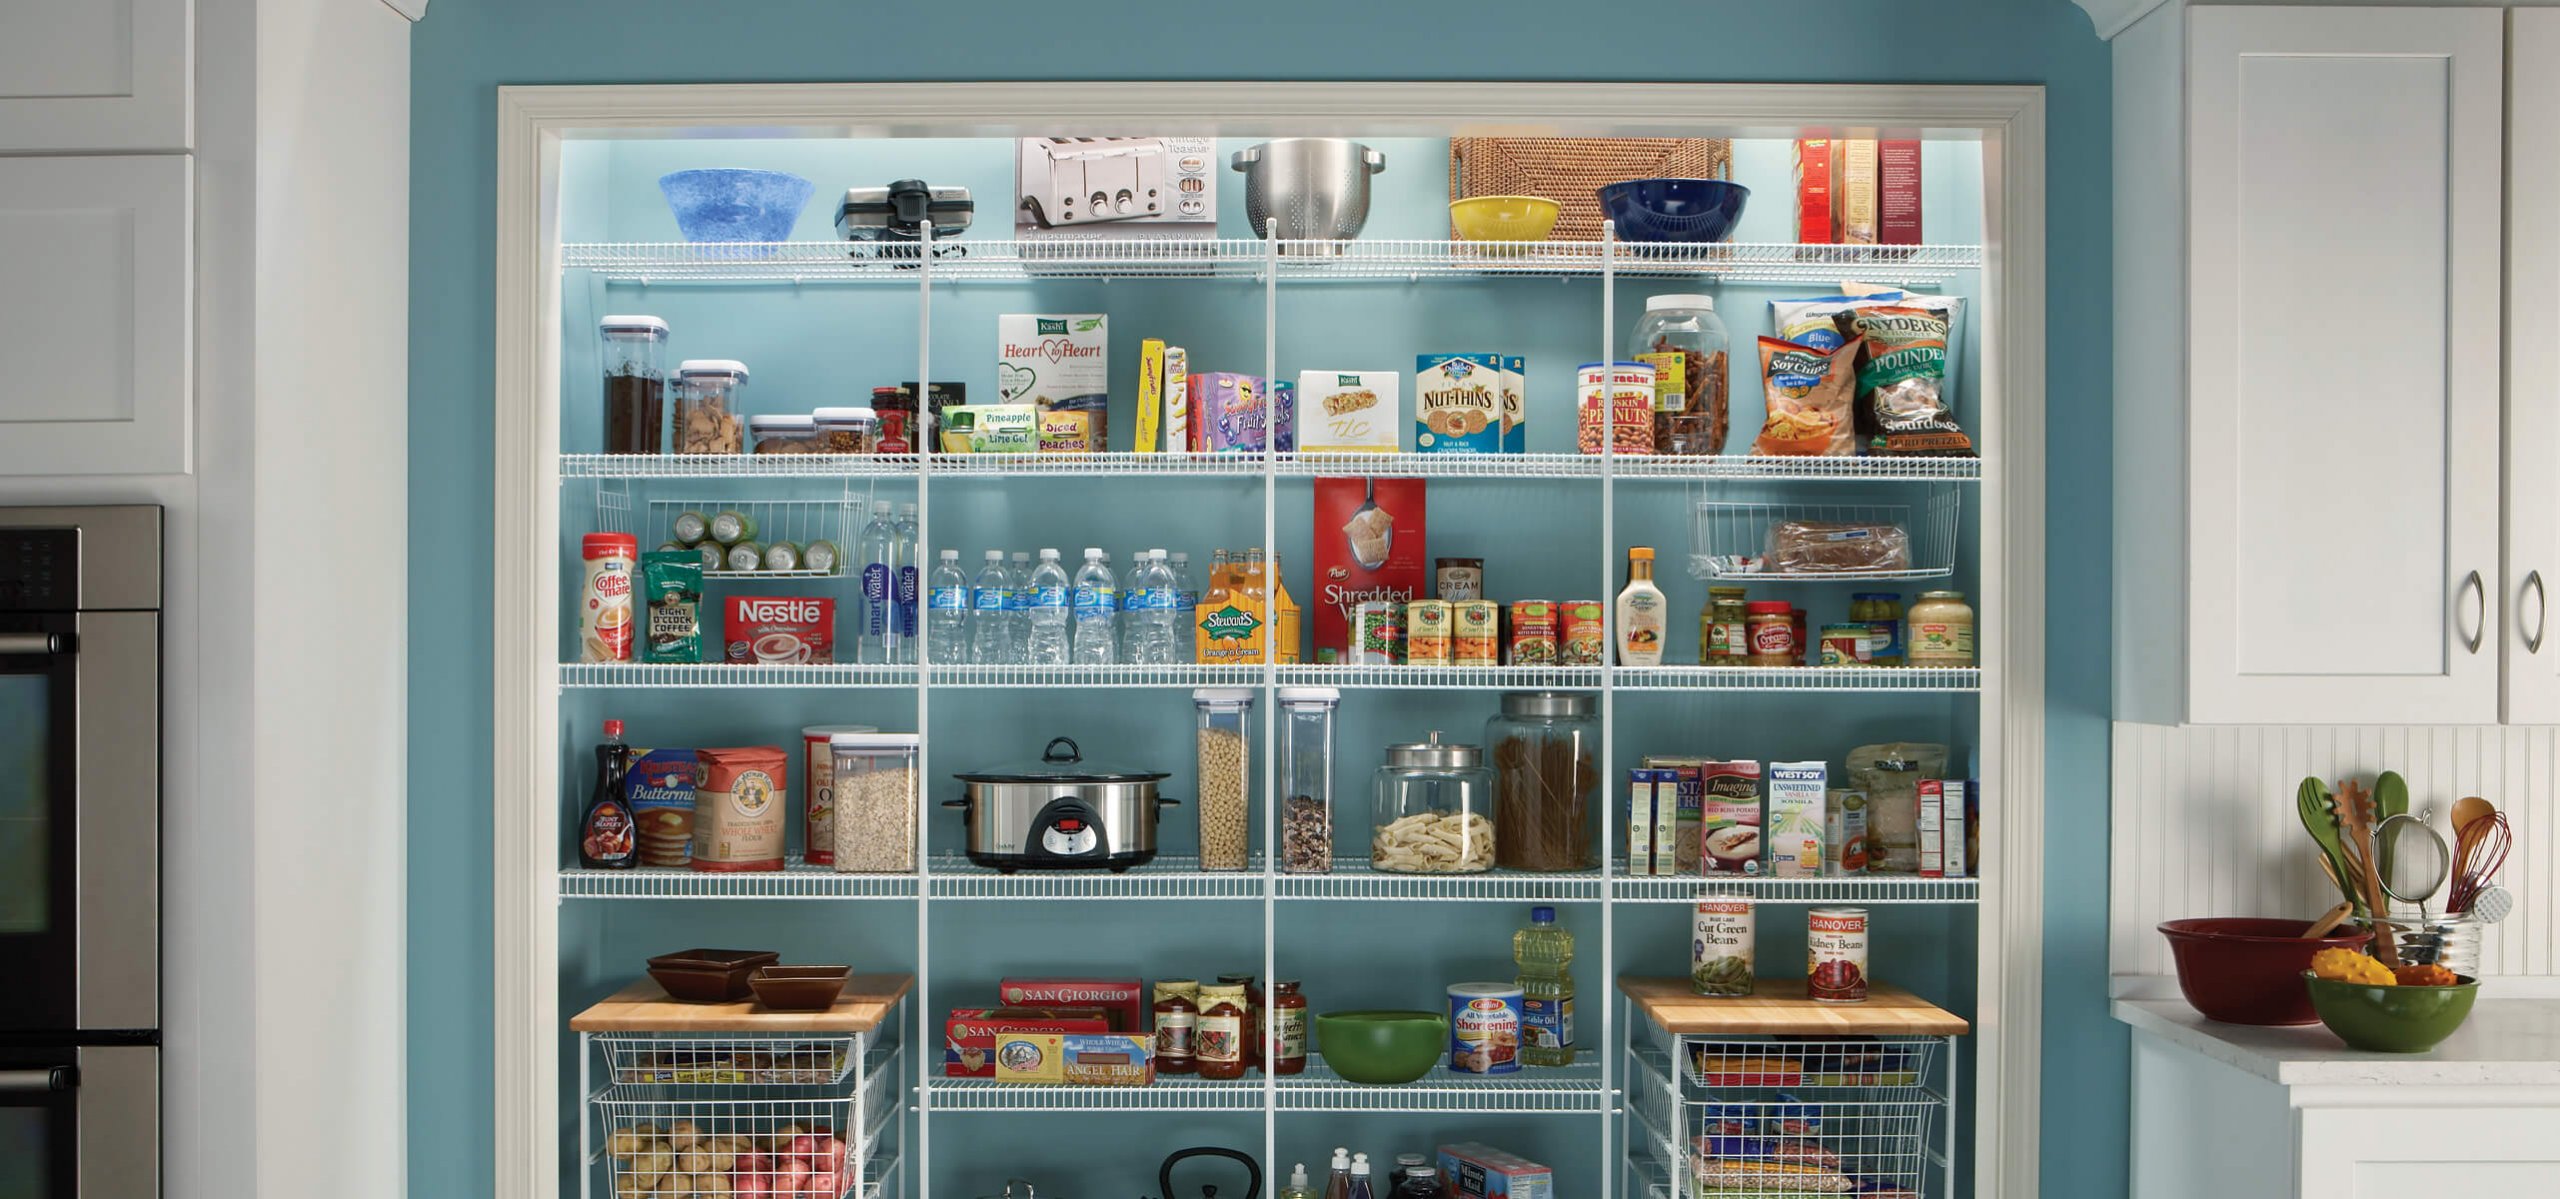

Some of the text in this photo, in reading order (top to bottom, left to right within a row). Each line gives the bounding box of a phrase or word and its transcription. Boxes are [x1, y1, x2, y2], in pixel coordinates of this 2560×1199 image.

[1040, 322, 1065, 331] Kashi
[1808, 333, 1831, 342] Blue
[1005, 344, 1043, 357] Heart
[1063, 344, 1101, 357] Heart
[1771, 360, 1828, 375] Soy Chips
[1588, 374, 1648, 385] Nutracker
[1597, 398, 1638, 408] RDSKIN
[986, 413, 1031, 423] Pineapple
[1589, 408, 1647, 423] PENUTS
[1046, 422, 1077, 432] Diced
[1236, 412, 1260, 434] Fruit
[1880, 415, 1961, 433] Sourdoug
[988, 433, 1028, 443] Lime Gel
[1040, 439, 1085, 450] Peaches
[595, 574, 628, 592] Coffee
[1439, 581, 1479, 590] CREAM
[604, 585, 631, 598] mate
[1324, 584, 1413, 605] Shredded
[738, 600, 821, 623] Nestlé
[653, 616, 692, 624] O'CLOCK
[654, 624, 690, 632] COFFEE
[1235, 647, 1259, 657] Cream
[632, 784, 696, 800] Buttermi
[1774, 783, 1821, 791] UNSWEETENED
[720, 827, 751, 837] WHOLE
[1701, 903, 1746, 912] HANOVER
[1698, 921, 1748, 934] Cut Green
[1811, 919, 1863, 930] HANOVER
[1706, 933, 1739, 945] Beans
[1838, 939, 1863, 949] Beans
[1025, 988, 1129, 1003] SAN GIORGIO
[1456, 1017, 1518, 1032] Shortening
[969, 1026, 997, 1036] SAN
[1067, 1064, 1141, 1075] ANGEL HAIR
[1461, 1164, 1484, 1182] Minute
[1463, 1177, 1481, 1192] Maid
